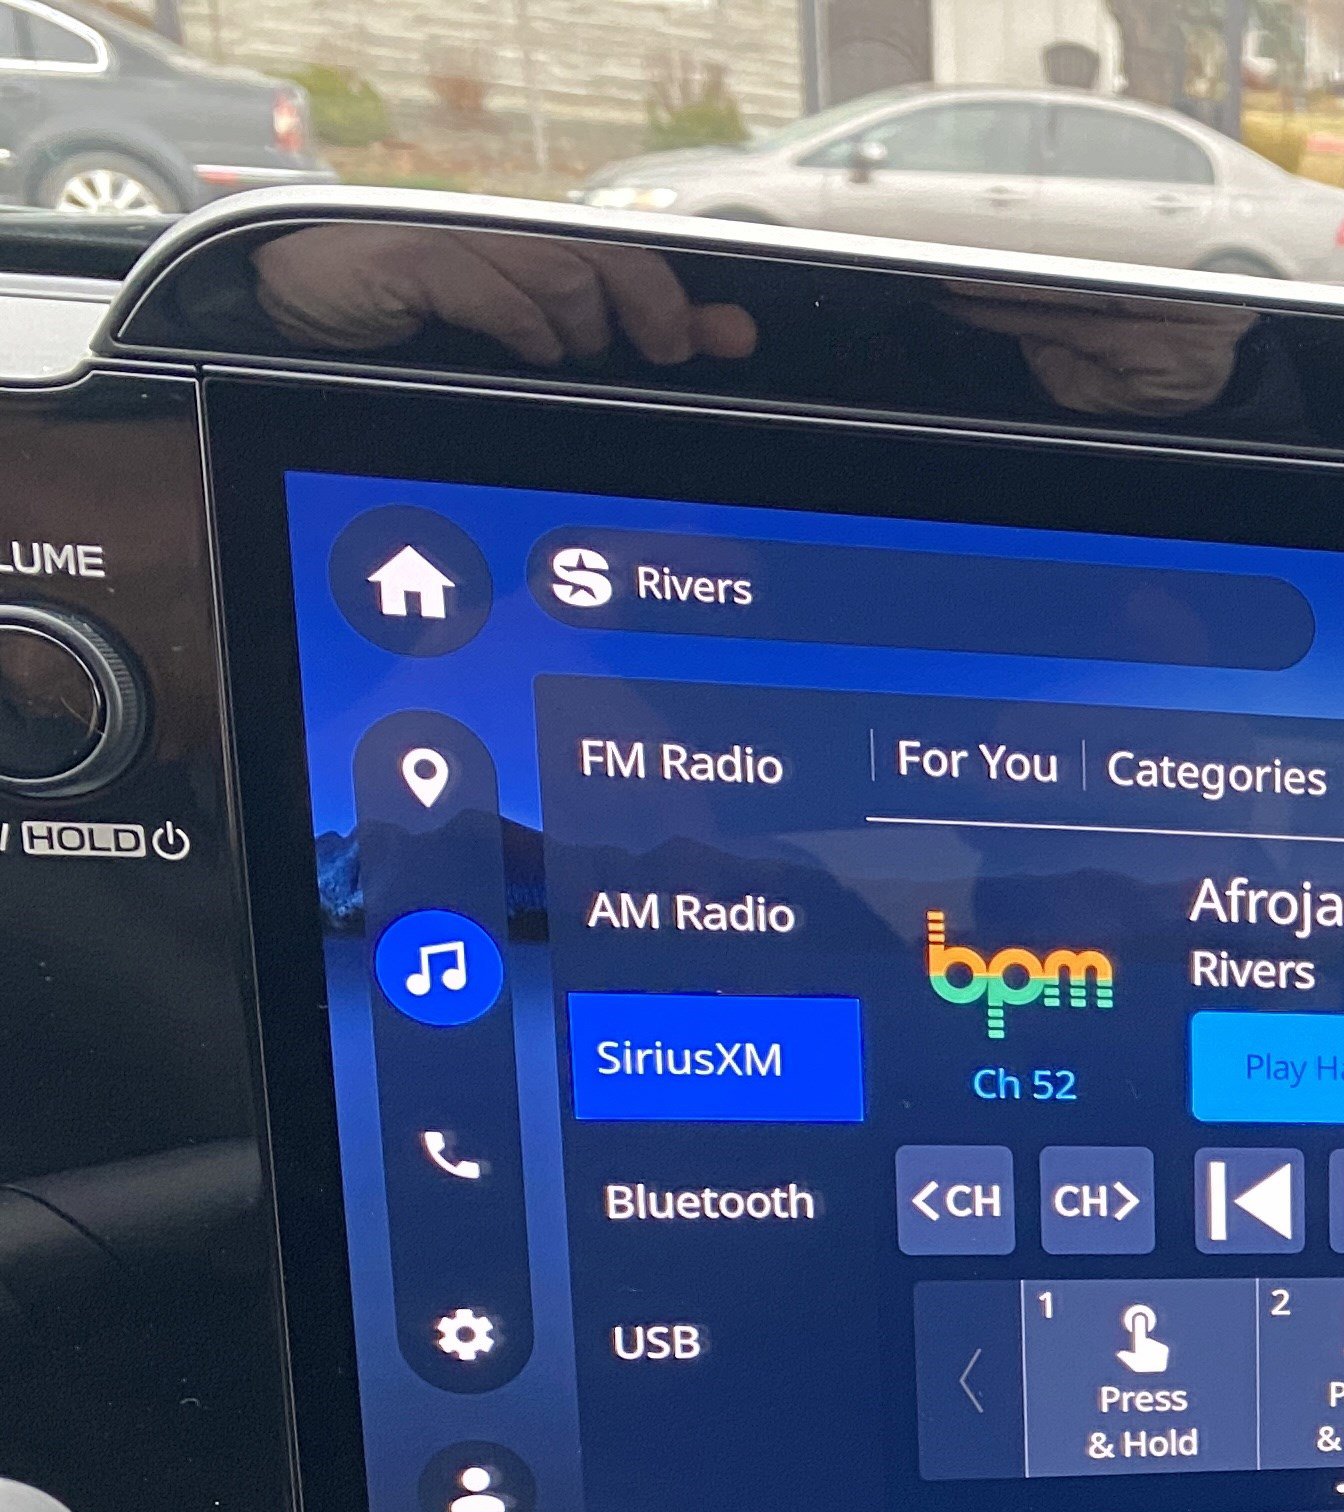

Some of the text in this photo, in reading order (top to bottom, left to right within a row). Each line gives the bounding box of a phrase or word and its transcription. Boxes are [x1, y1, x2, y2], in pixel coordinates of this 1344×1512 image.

[637, 566, 753, 605] Rivers
[581, 738, 784, 785] FM Radio
[898, 740, 1058, 783] For You
[1108, 750, 1327, 801] Categories
[27, 826, 140, 852] HOLD
[587, 892, 795, 933] AM Radio
[926, 909, 1114, 1039] bpm
[1192, 950, 1316, 990] Rivers
[597, 1040, 781, 1077] SiriusXM
[1246, 1053, 1304, 1088] Play
[973, 1067, 1077, 1100] Ch 52
[606, 1183, 815, 1220] Bluetooth
[945, 1184, 1001, 1217] CH
[1054, 1184, 1108, 1217] CH
[1038, 1291, 1053, 1319] 1
[1270, 1288, 1291, 1316] 2
[614, 1325, 701, 1360] USB
[1100, 1385, 1188, 1413] Press
[1088, 1427, 1198, 1459] & Hold
[1316, 1425, 1342, 1452] &
